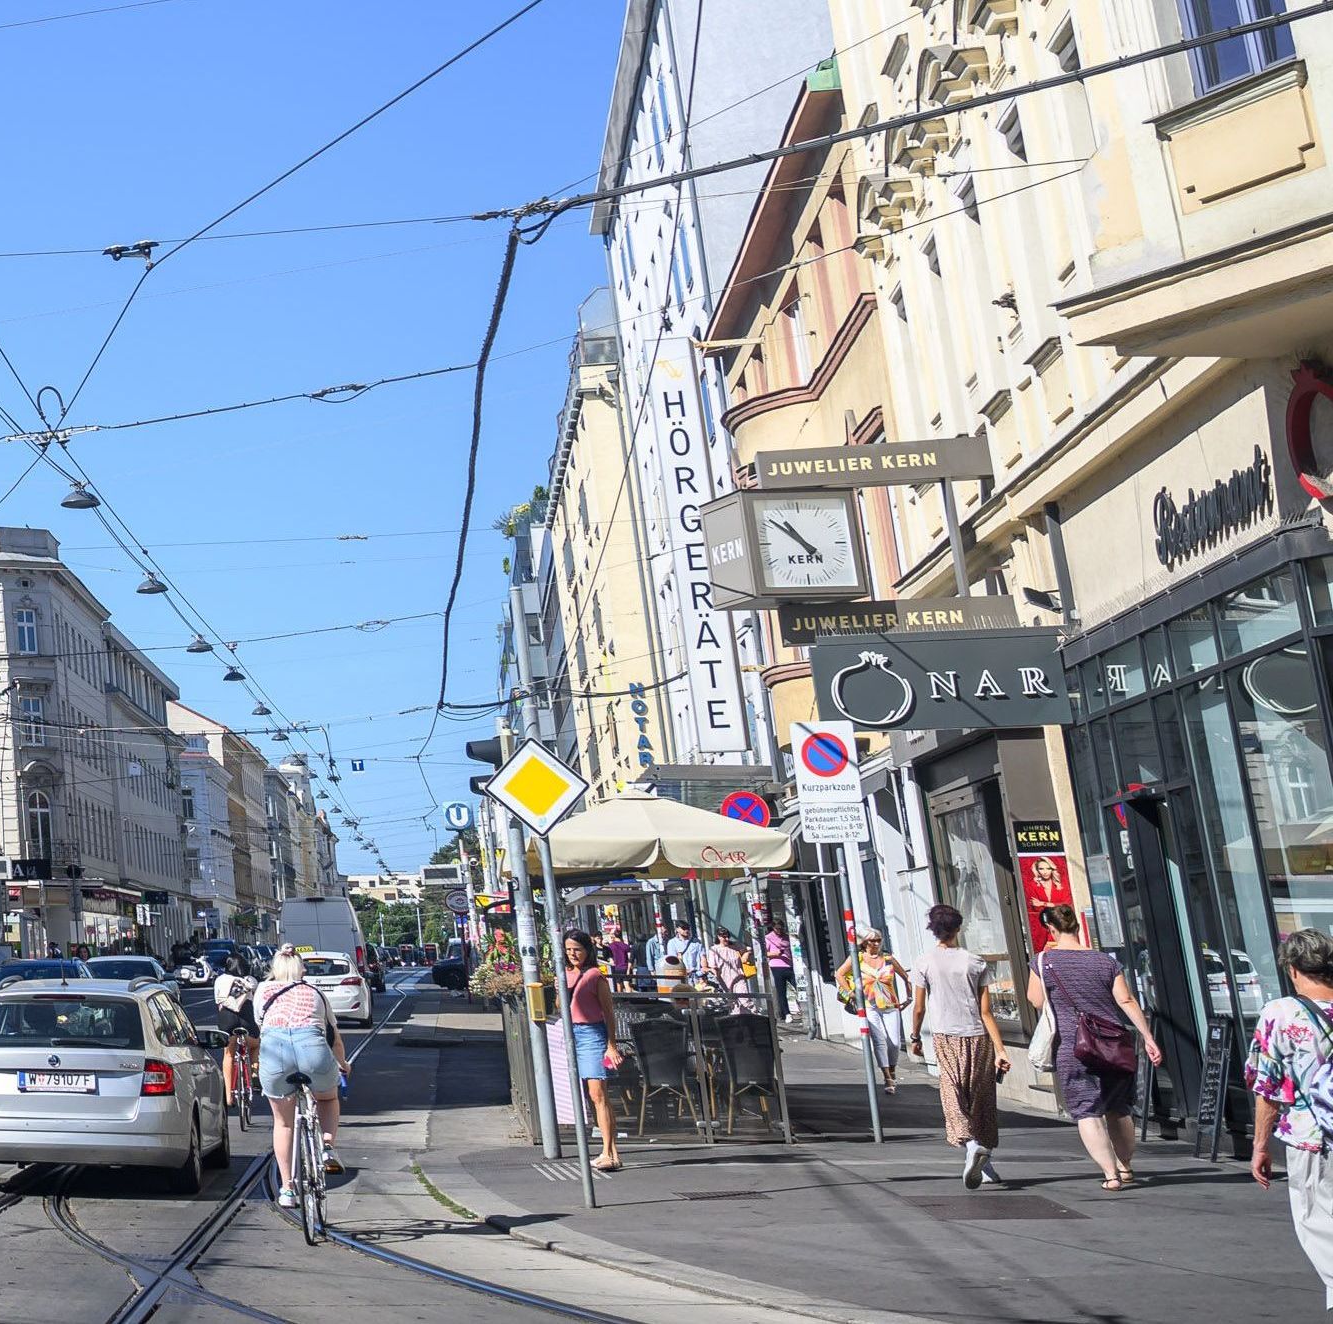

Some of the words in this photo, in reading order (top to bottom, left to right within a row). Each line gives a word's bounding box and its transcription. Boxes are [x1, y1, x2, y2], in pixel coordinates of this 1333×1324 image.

[768, 457, 873, 477] JUWELIER
[881, 452, 937, 470] KERN
[662, 390, 732, 730] HÖRGERÄTE
[712, 537, 744, 567] KERN
[788, 554, 824, 564] KERN
[792, 612, 899, 632] JUWELIER
[907, 609, 965, 627] KERN
[629, 682, 655, 769] NOTAR
[802, 784, 856, 793] Kurzparkzone
[449, 807, 469, 827] U
[1017, 831, 1060, 842] KERN
[28, 1074, 37, 1086] W
[46, 1075, 81, 1086] 79107
[84, 1075, 91, 1086] F
